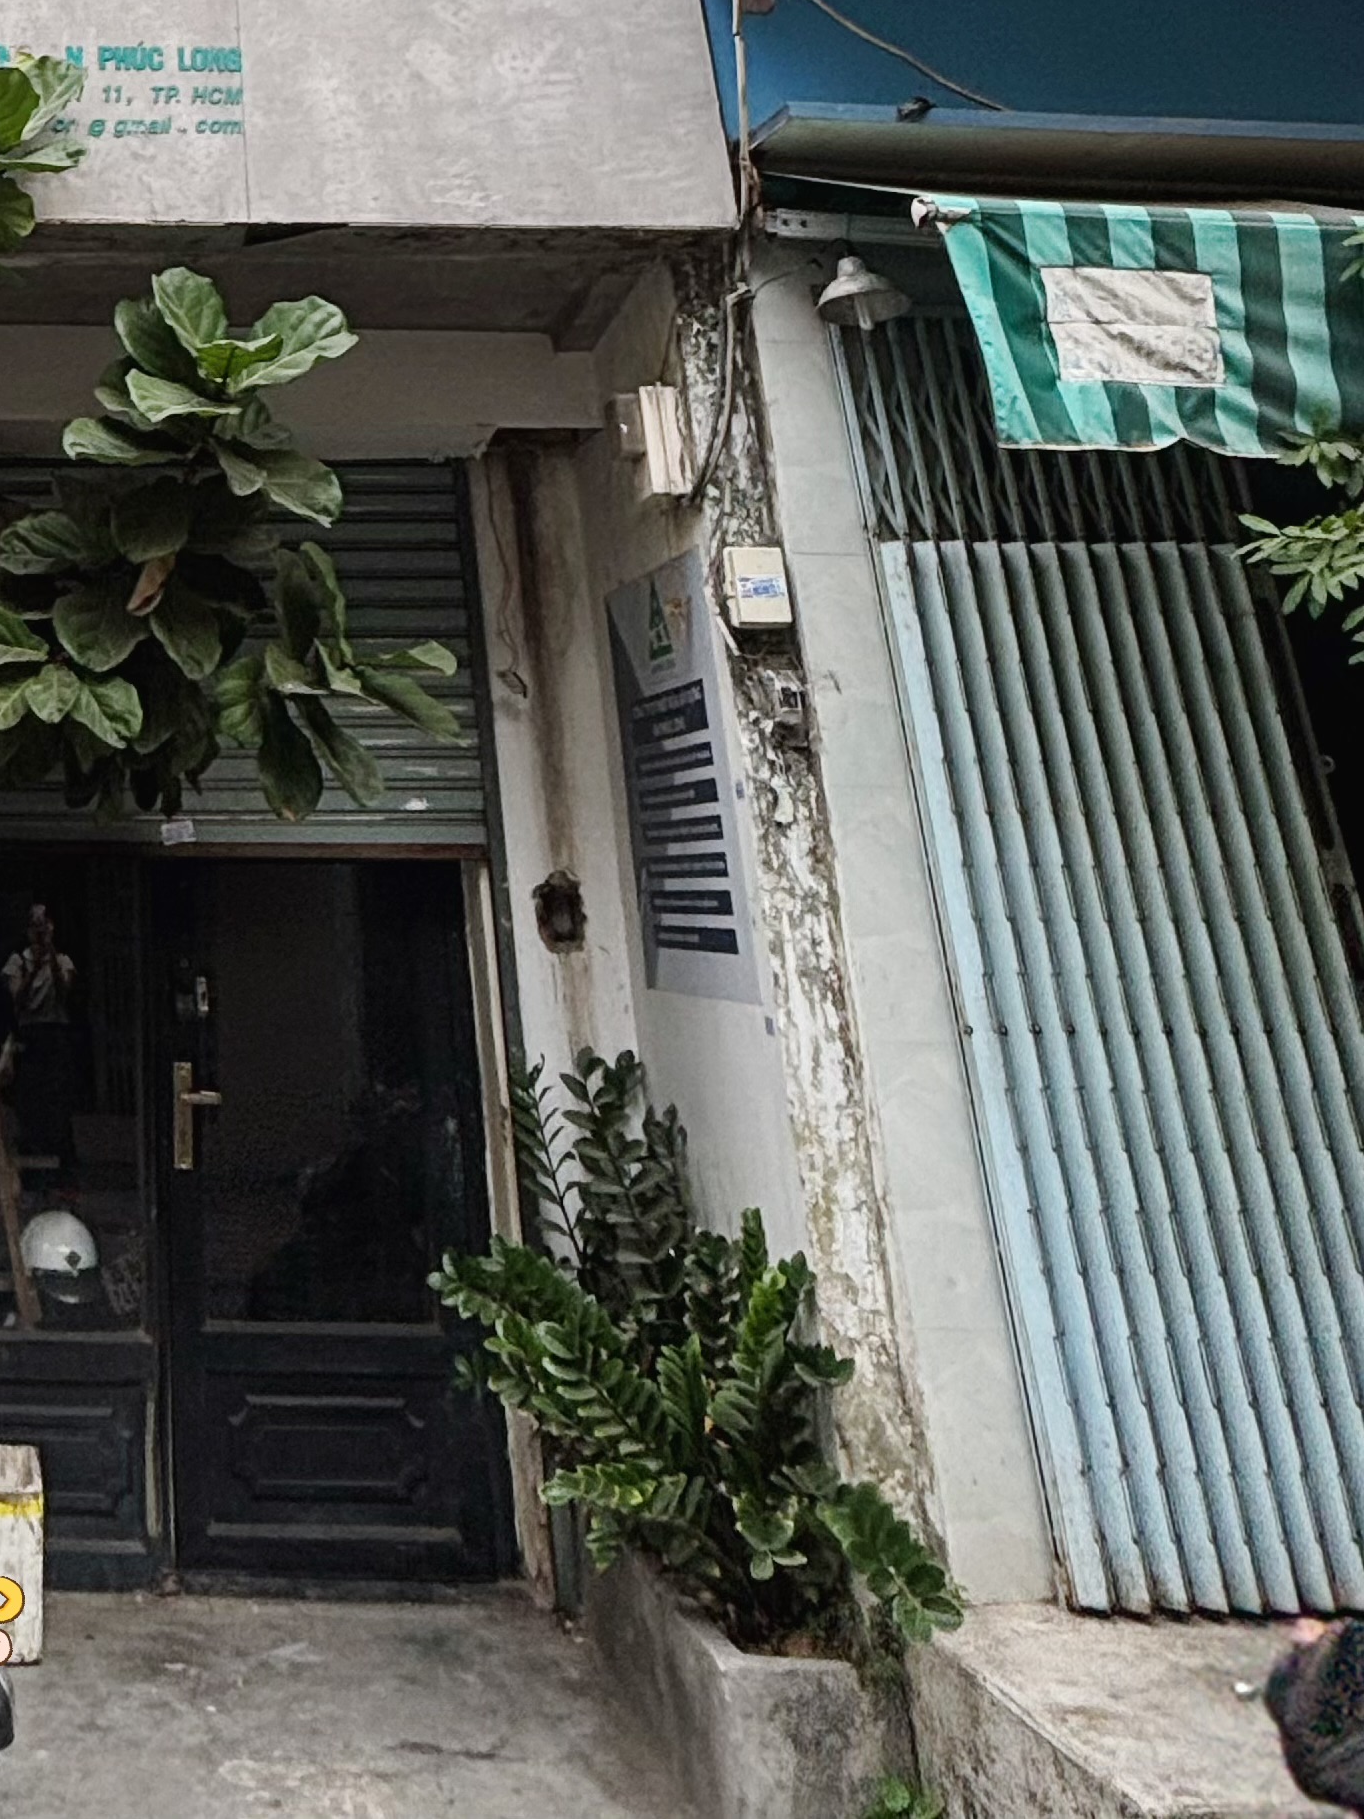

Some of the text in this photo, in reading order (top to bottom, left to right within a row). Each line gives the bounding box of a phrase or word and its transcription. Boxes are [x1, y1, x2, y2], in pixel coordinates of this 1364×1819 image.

[98, 40, 164, 72] PHÚC
[177, 46, 243, 73] LONG
[102, 85, 134, 106] 11,
[151, 86, 182, 105] TP.
[192, 86, 244, 106] HCM
